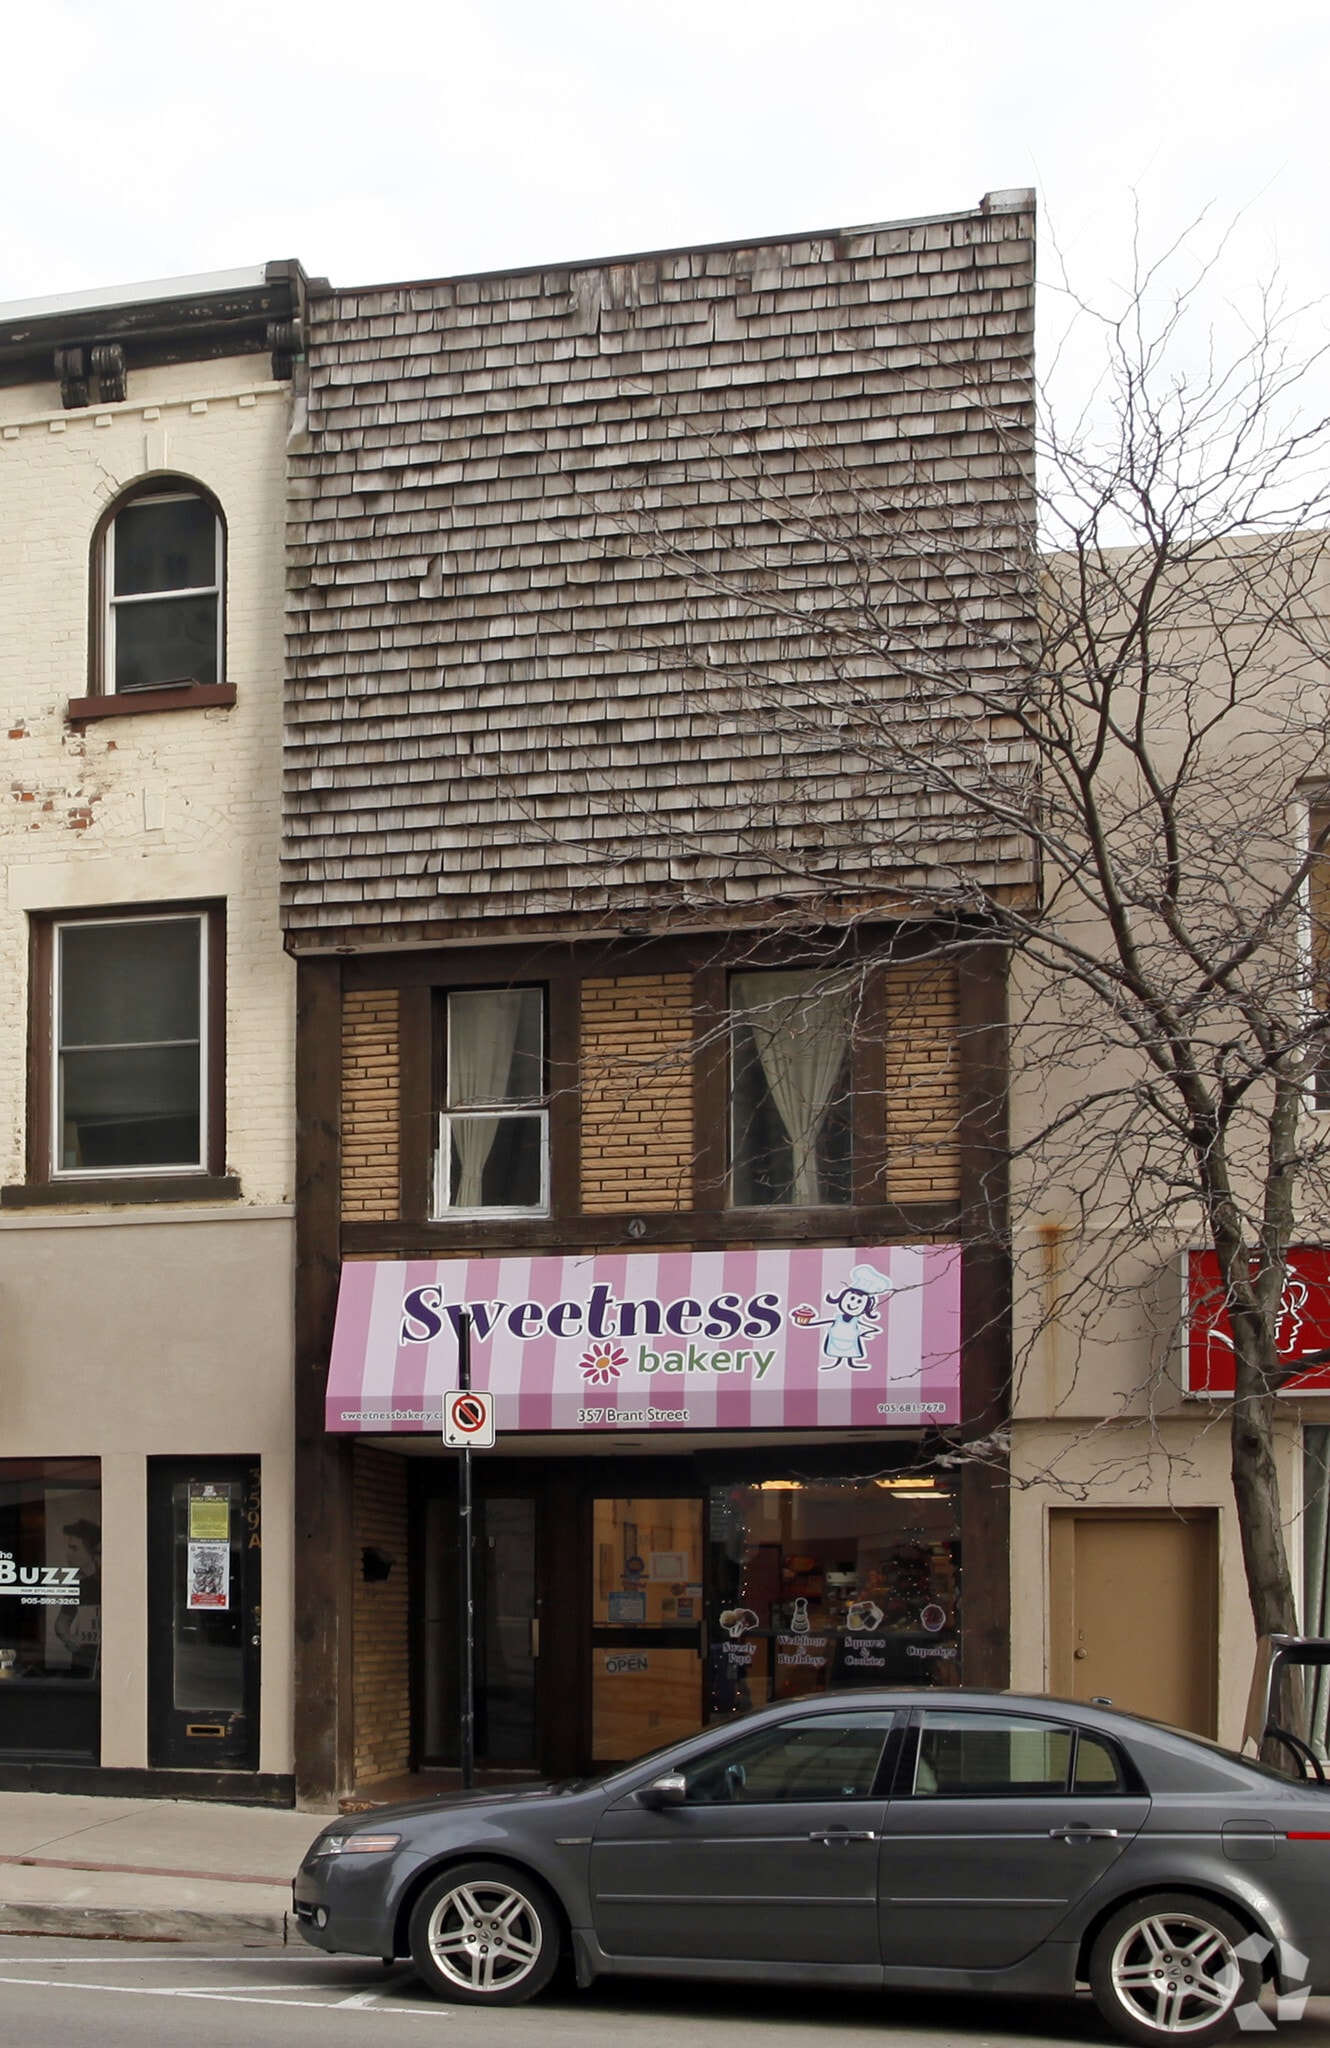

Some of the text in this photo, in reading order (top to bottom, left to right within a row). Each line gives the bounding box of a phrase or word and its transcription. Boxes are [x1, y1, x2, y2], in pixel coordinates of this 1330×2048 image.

[402, 1283, 782, 1342] Sweetness
[639, 1344, 776, 1379] bakery
[878, 1403, 945, 1413] 905.681.7678
[578, 1408, 689, 1422] 357 Brant Street
[777, 1635, 827, 1647] Weddings
[844, 1636, 886, 1649] Squares
[906, 1645, 957, 1658] Cupcakes
[605, 1657, 649, 1674] OPEN
[728, 1653, 752, 1666] Pops
[777, 1654, 827, 1667] Birthdays
[844, 1655, 886, 1667] Cookies
